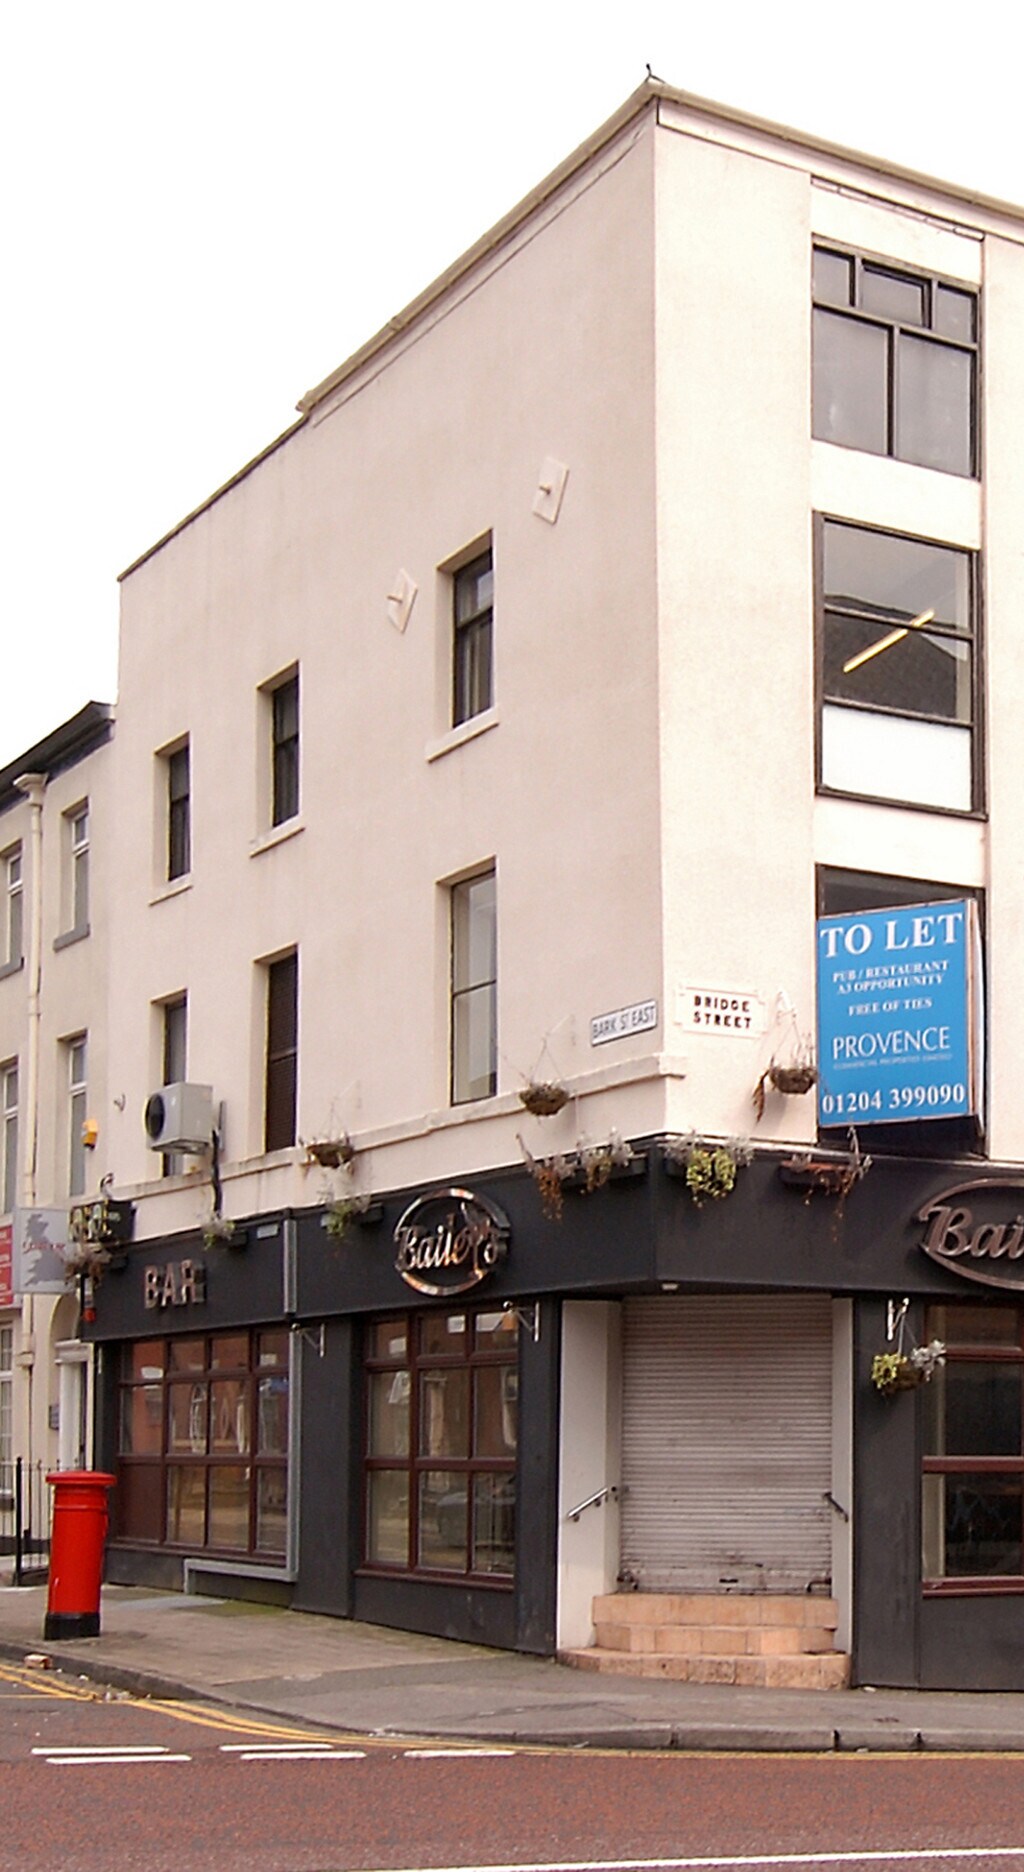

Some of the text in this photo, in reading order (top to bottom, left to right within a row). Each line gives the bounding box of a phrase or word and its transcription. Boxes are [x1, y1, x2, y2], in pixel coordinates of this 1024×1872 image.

[820, 912, 963, 958] TO LET
[833, 969, 856, 983] PUB
[865, 960, 949, 979] RESTAURANT
[854, 973, 945, 993] OPPORTUNITY
[693, 995, 750, 1013] BRIDGE
[848, 997, 933, 1017] FREE OF TIES
[592, 1017, 617, 1039] BARK
[631, 1005, 655, 1027] EAST
[693, 1011, 752, 1029] STREET
[832, 1026, 950, 1060] PROVENCE
[821, 1083, 965, 1115] 01204 399090
[144, 1259, 200, 1309] BAR
